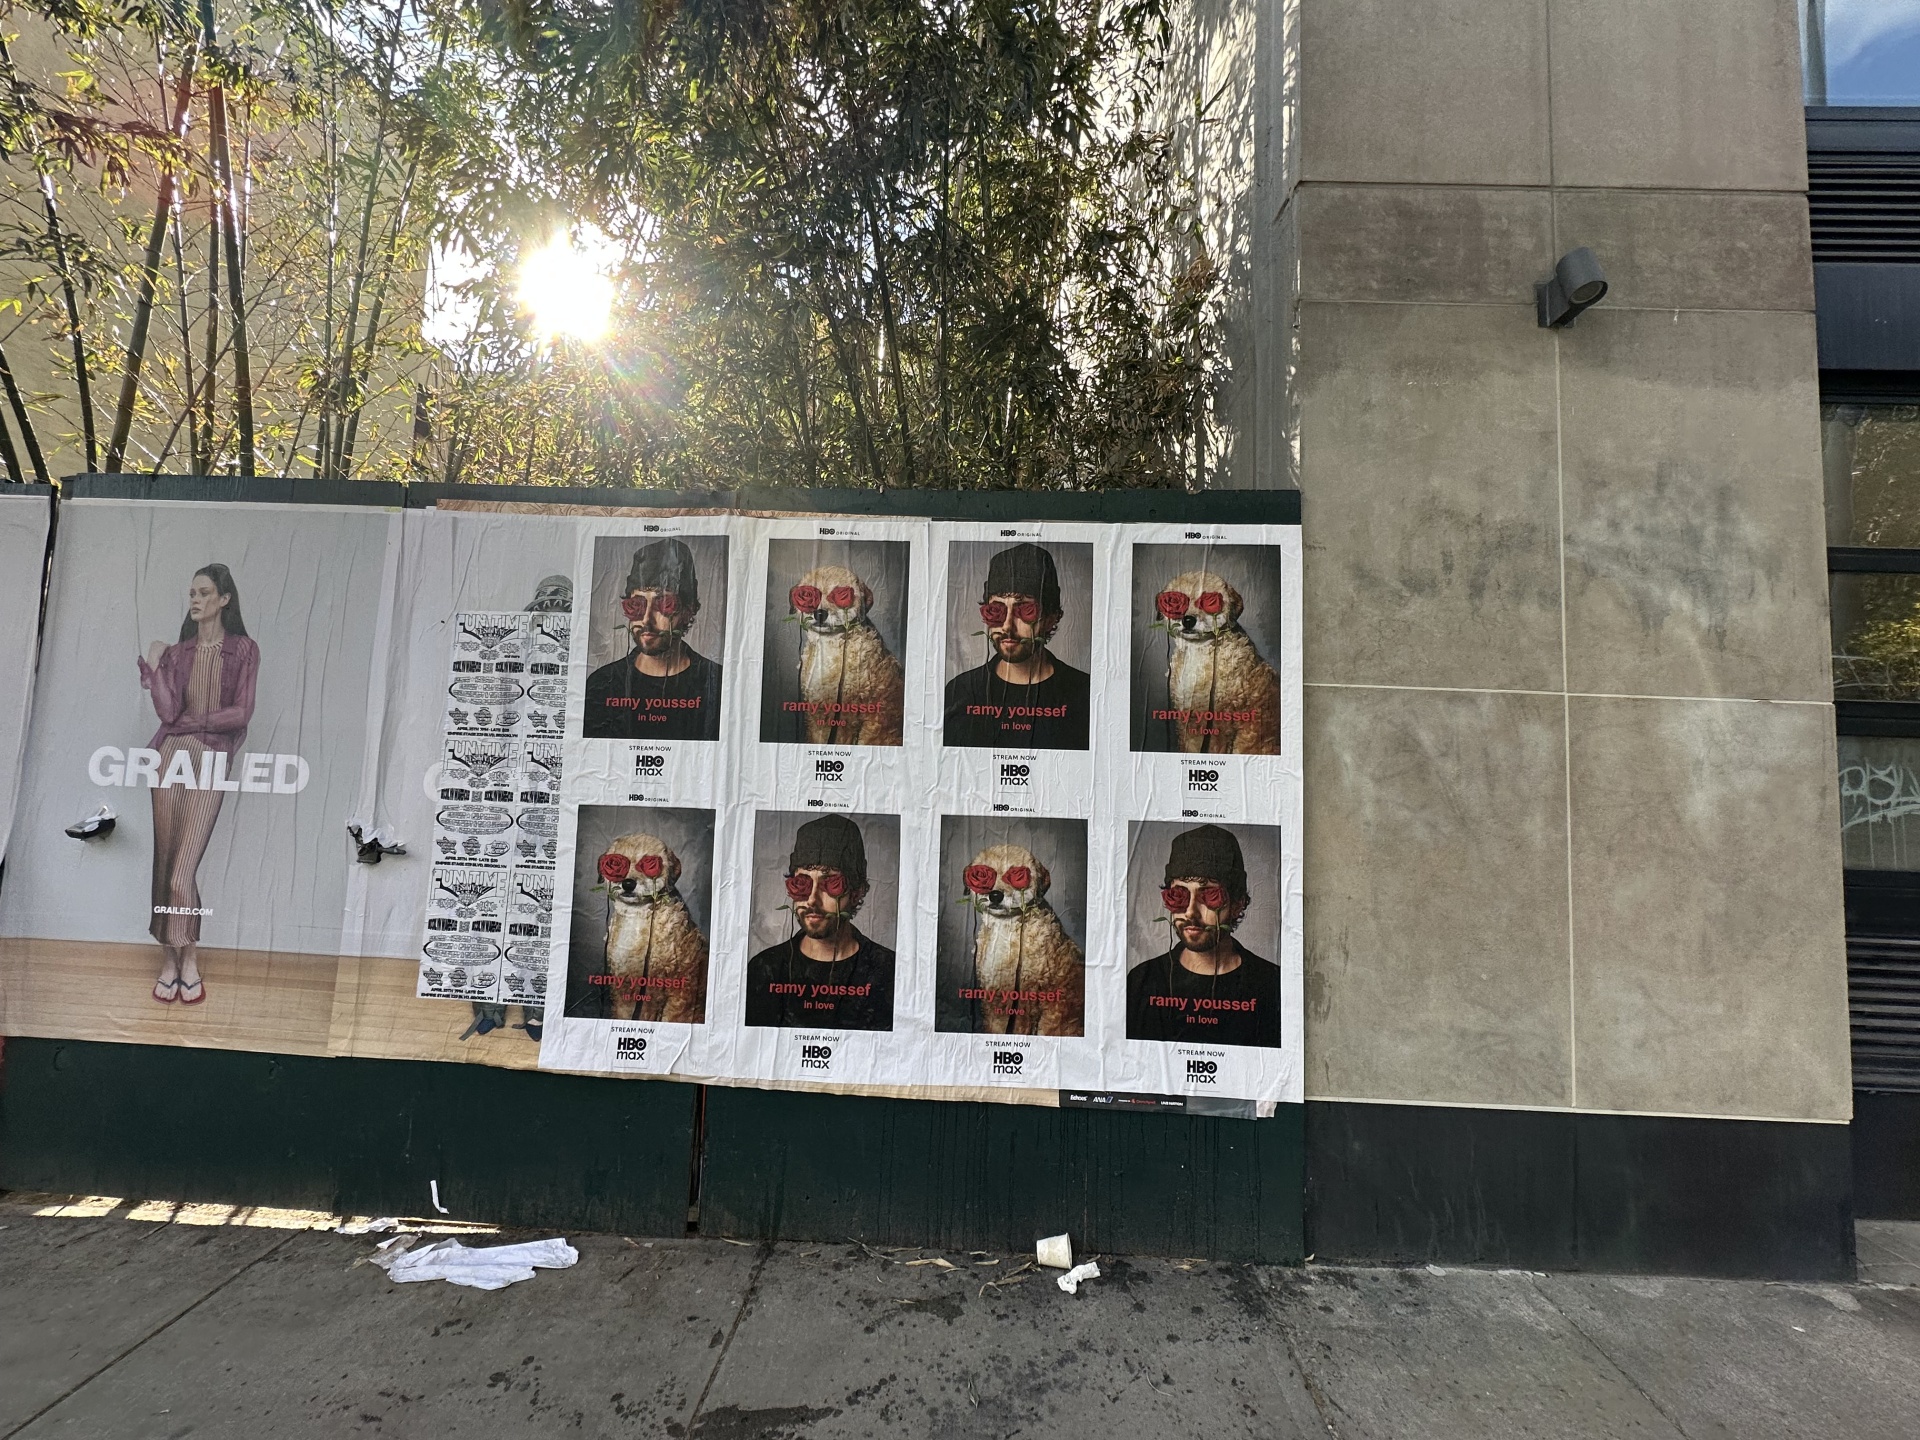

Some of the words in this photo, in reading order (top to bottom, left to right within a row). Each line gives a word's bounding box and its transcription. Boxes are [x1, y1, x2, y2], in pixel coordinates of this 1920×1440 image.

[606, 697, 640, 710] ramy
[645, 696, 701, 710] youssef
[783, 701, 819, 715] ramy
[824, 701, 882, 715] youssef
[638, 713, 646, 721] in
[649, 713, 667, 722] love
[966, 705, 1003, 718] ramy
[1008, 705, 1067, 719] youssef
[1152, 710, 1191, 723] ramy
[1195, 710, 1257, 724] youssef
[817, 718, 825, 726] in
[828, 718, 847, 727] love
[1001, 722, 1010, 730] in
[1012, 722, 1031, 730] love
[1200, 727, 1219, 735] love
[636, 755, 664, 767] HBO
[816, 760, 844, 772] HBO
[88, 746, 310, 794] GRAILED
[635, 767, 663, 776] max
[1001, 764, 1030, 777] HBO
[1188, 769, 1219, 782] HBO
[816, 773, 843, 782] max
[1000, 777, 1029, 786] max
[1188, 782, 1218, 792] max
[807, 799, 823, 807] HBO
[153, 905, 213, 916] GRAILED.COM
[588, 974, 624, 989] ramy
[630, 975, 687, 989] youssef
[769, 982, 806, 997] ramy
[811, 983, 871, 997] youssef
[622, 992, 630, 1000] in
[633, 993, 651, 1001] love
[958, 988, 996, 1003] ramy
[1001, 989, 1062, 1003] youssef
[804, 1000, 812, 1009] in
[815, 1001, 835, 1010] love
[1149, 995, 1188, 1011] ramy
[1193, 998, 1257, 1012] youssef
[995, 1007, 1002, 1015] in
[1006, 1007, 1025, 1015] love
[1186, 1014, 1196, 1023] in
[1198, 1015, 1219, 1025] love
[618, 1037, 646, 1051] HBO
[616, 1051, 645, 1061] max
[802, 1045, 832, 1059] HBO
[993, 1052, 1023, 1065] HBO
[801, 1059, 830, 1070] max
[993, 1065, 1022, 1075] max
[1187, 1060, 1217, 1074] HBO
[1186, 1074, 1216, 1084] max
